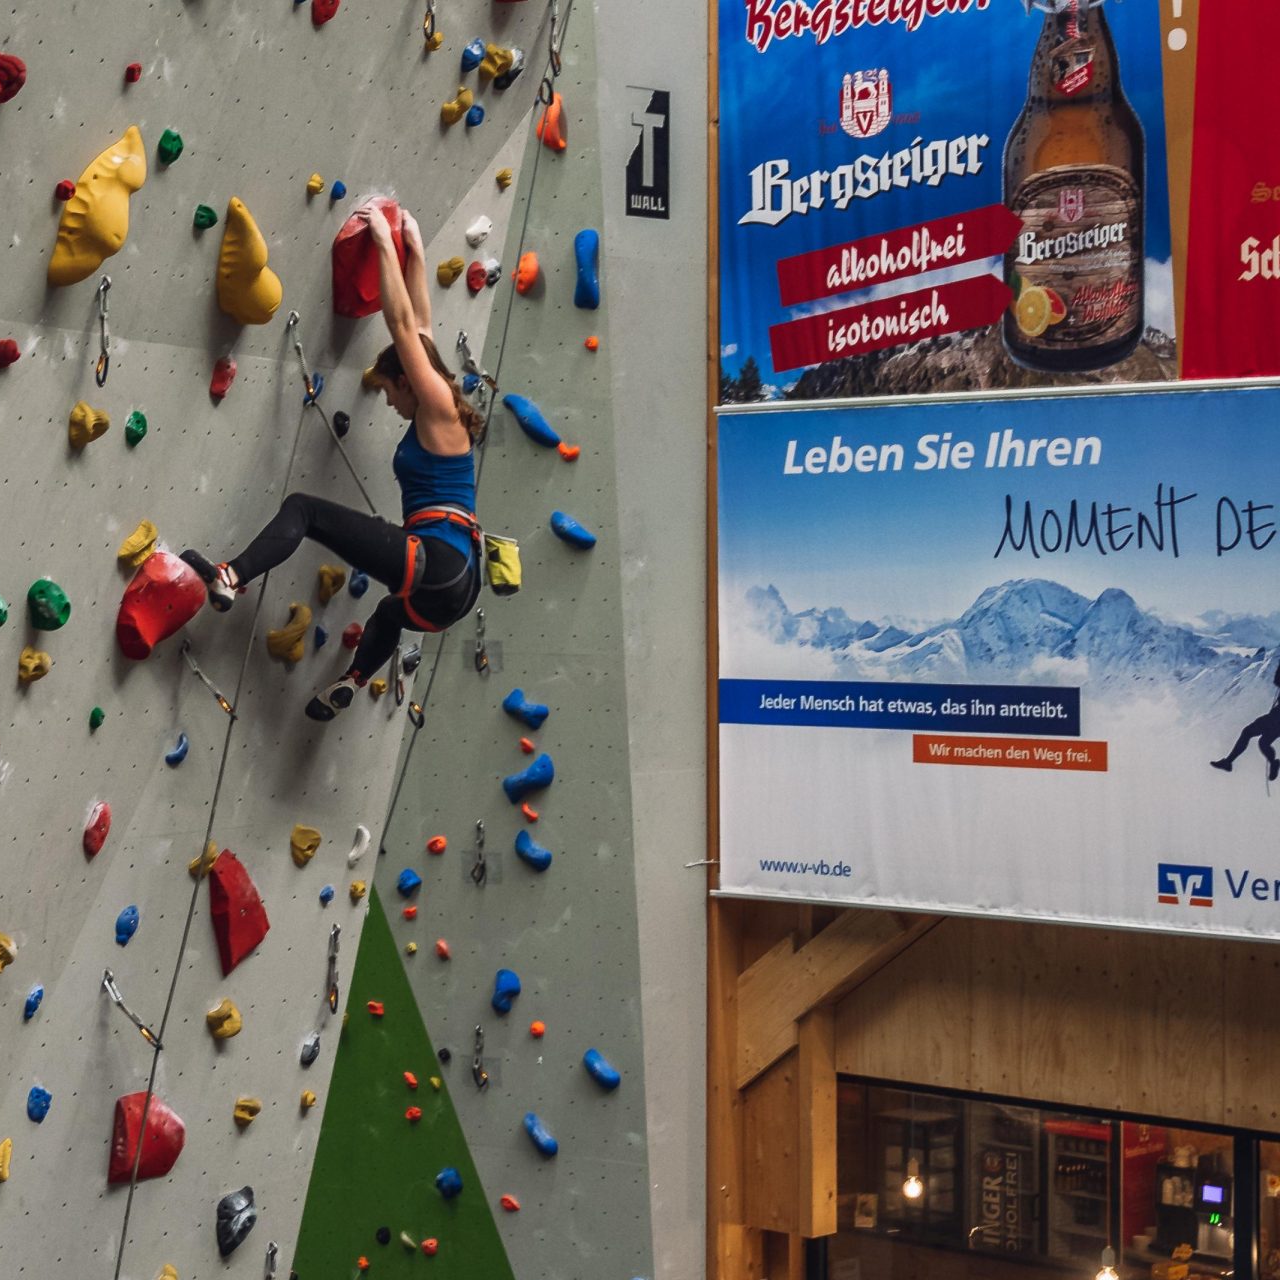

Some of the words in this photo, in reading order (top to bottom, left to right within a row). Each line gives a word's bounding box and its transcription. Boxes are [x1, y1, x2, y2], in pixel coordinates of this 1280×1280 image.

[737, 135, 989, 226] Bergsteiger
[630, 194, 666, 212] WALL
[826, 223, 966, 288] alkoholfrei
[1015, 222, 1127, 265] Bergsteiger
[827, 290, 950, 353] isotonisch
[783, 436, 904, 475] Leben
[913, 432, 975, 471] Sie
[985, 429, 1102, 468] Ihren
[994, 483, 1198, 559] MOMENT
[1216, 496, 1277, 557] DE
[759, 694, 797, 710] Jeder
[800, 695, 855, 712] Mensch
[859, 697, 884, 713] hat
[887, 700, 937, 716] etwas,
[941, 700, 967, 716] das
[971, 700, 996, 717] ihn
[1000, 702, 1068, 719] antreibt.
[929, 743, 951, 757] Wir
[954, 744, 1002, 759] machen
[1005, 746, 1030, 761] den
[1033, 748, 1063, 764] Weg
[1066, 748, 1092, 763] frei.
[759, 859, 852, 877] www.v-vb.de
